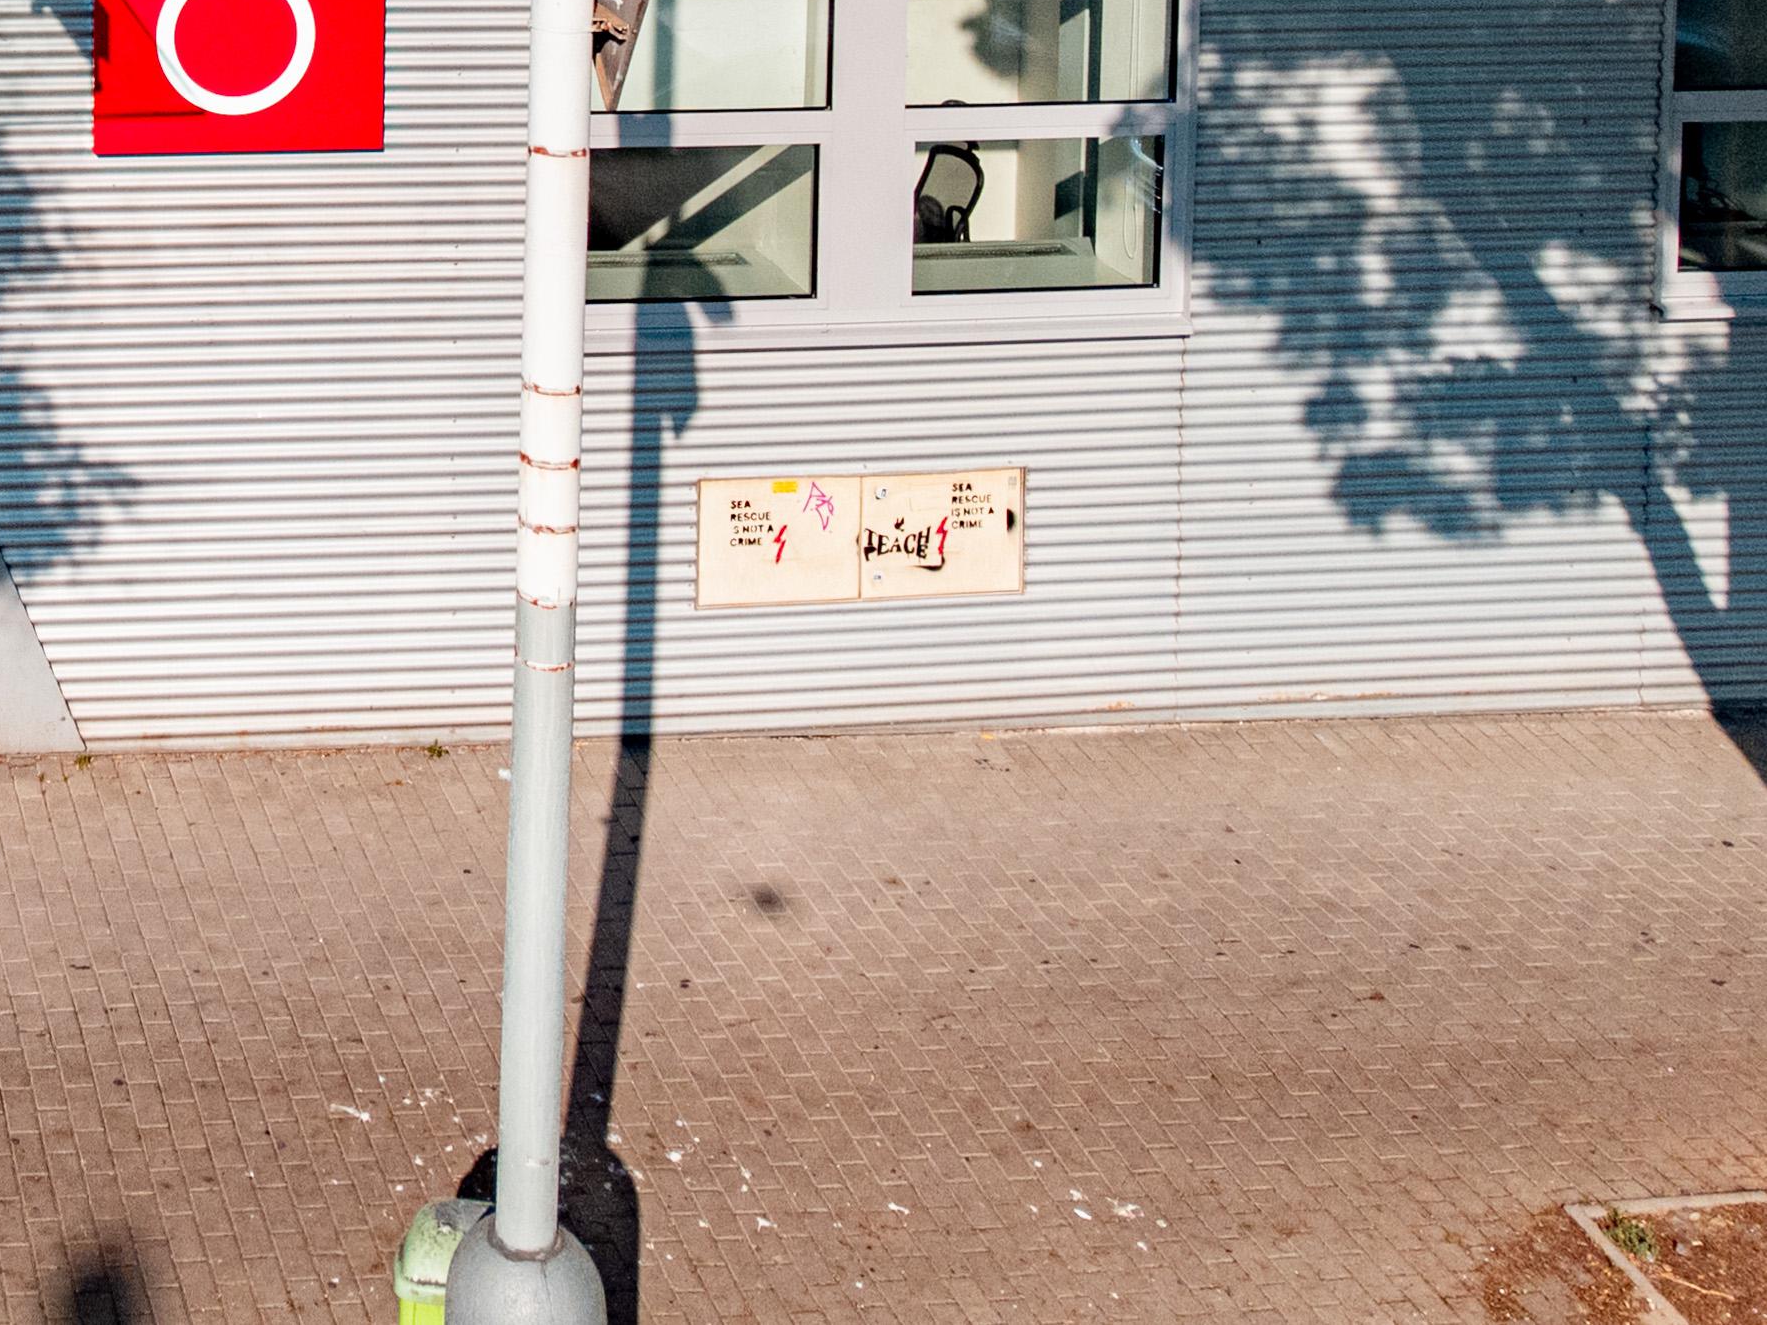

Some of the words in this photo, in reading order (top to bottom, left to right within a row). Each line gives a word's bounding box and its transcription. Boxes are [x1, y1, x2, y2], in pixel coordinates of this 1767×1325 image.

[952, 482, 972, 492] SEA
[952, 494, 991, 504] RESCUE
[730, 500, 751, 509] SEA
[730, 511, 771, 522] RESCUE
[951, 508, 960, 517] IS
[963, 507, 984, 516] NOT
[742, 524, 763, 533] NOT
[767, 524, 774, 533] A
[951, 520, 982, 529] CRIME
[730, 537, 762, 547] CRIME
